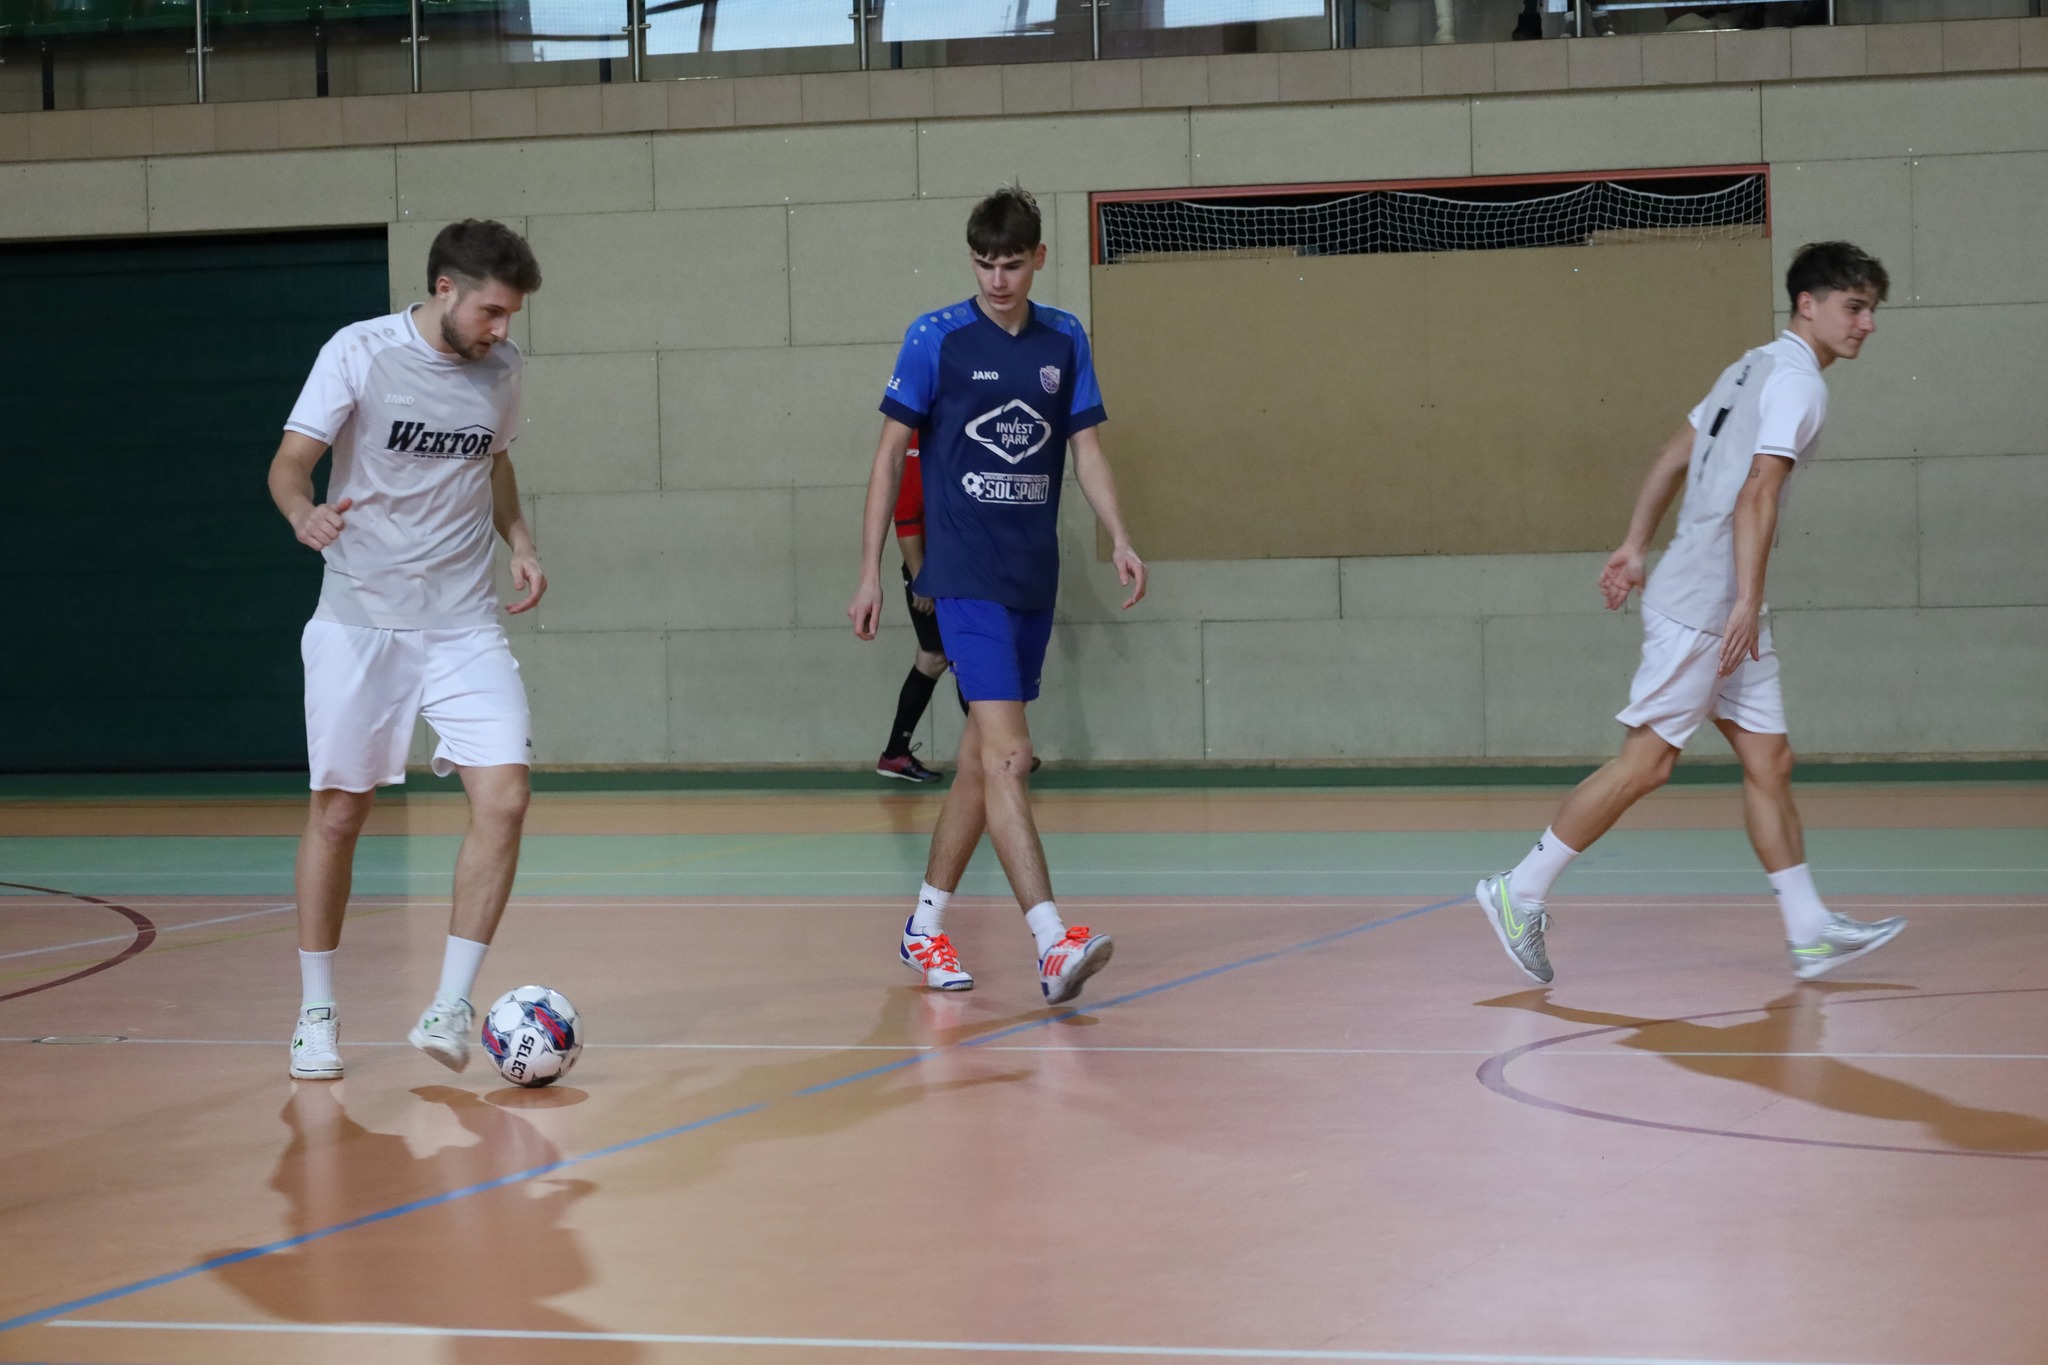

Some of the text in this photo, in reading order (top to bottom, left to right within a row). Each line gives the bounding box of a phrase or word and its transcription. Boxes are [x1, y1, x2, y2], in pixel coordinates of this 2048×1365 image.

[972, 370, 999, 380] JAKO
[384, 393, 415, 406] JAKO
[996, 416, 1034, 434] INVEST
[386, 420, 493, 455] WEKTOR
[1001, 433, 1029, 449] PARK
[509, 1034, 535, 1080] SELECT
